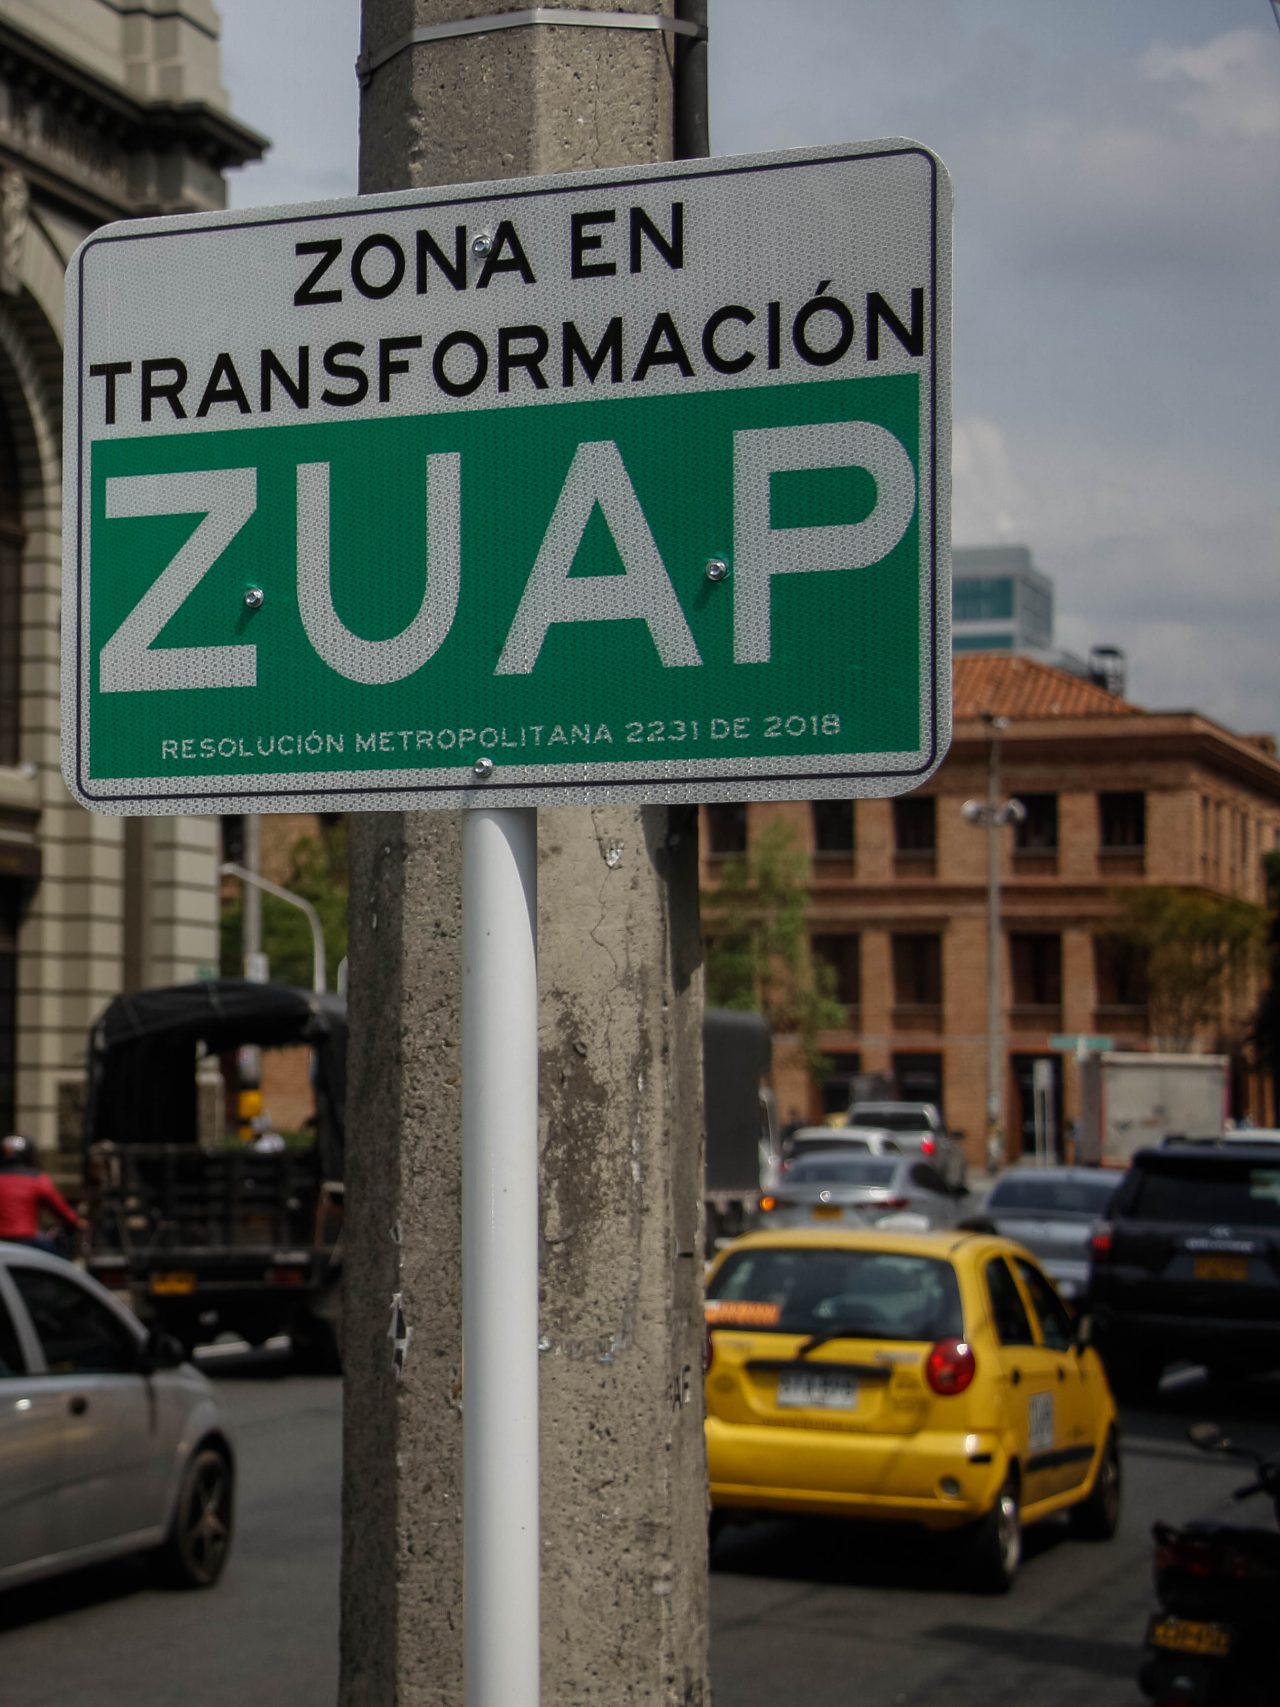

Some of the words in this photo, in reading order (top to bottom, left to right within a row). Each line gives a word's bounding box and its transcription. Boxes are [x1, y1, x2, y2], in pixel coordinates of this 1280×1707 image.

[293, 219, 537, 307] ZONA
[570, 201, 685, 280] EN
[89, 280, 925, 426] TRANSFORMACIÓN
[99, 419, 917, 694] ZUAP
[161, 729, 345, 761] RESOLUCIÓN
[354, 721, 614, 754] METROPOLITANA
[624, 721, 700, 744] 2231
[710, 716, 752, 741] DE
[762, 713, 842, 738] 2018
